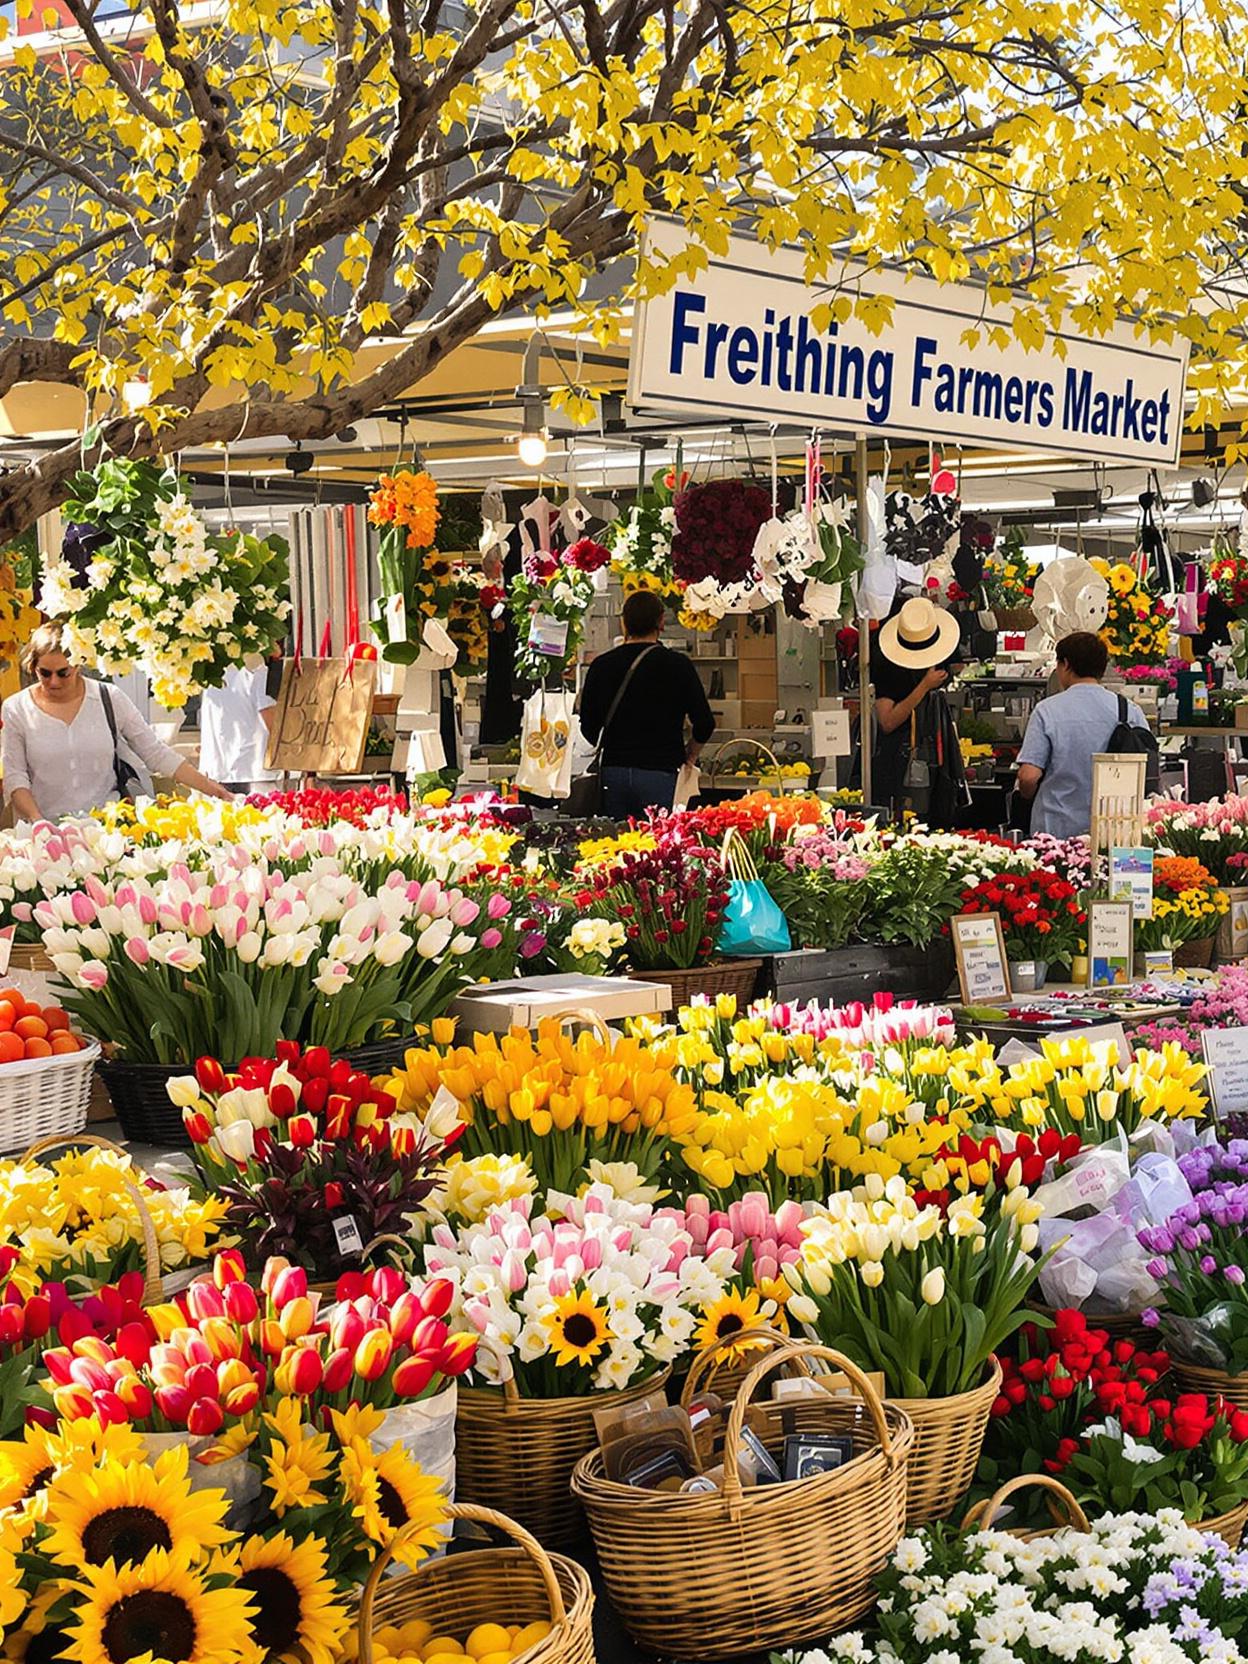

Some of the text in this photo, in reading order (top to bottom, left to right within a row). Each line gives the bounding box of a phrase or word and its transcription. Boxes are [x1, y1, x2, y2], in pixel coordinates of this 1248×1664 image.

[669, 291, 1170, 445] Freithing Farmers Market
